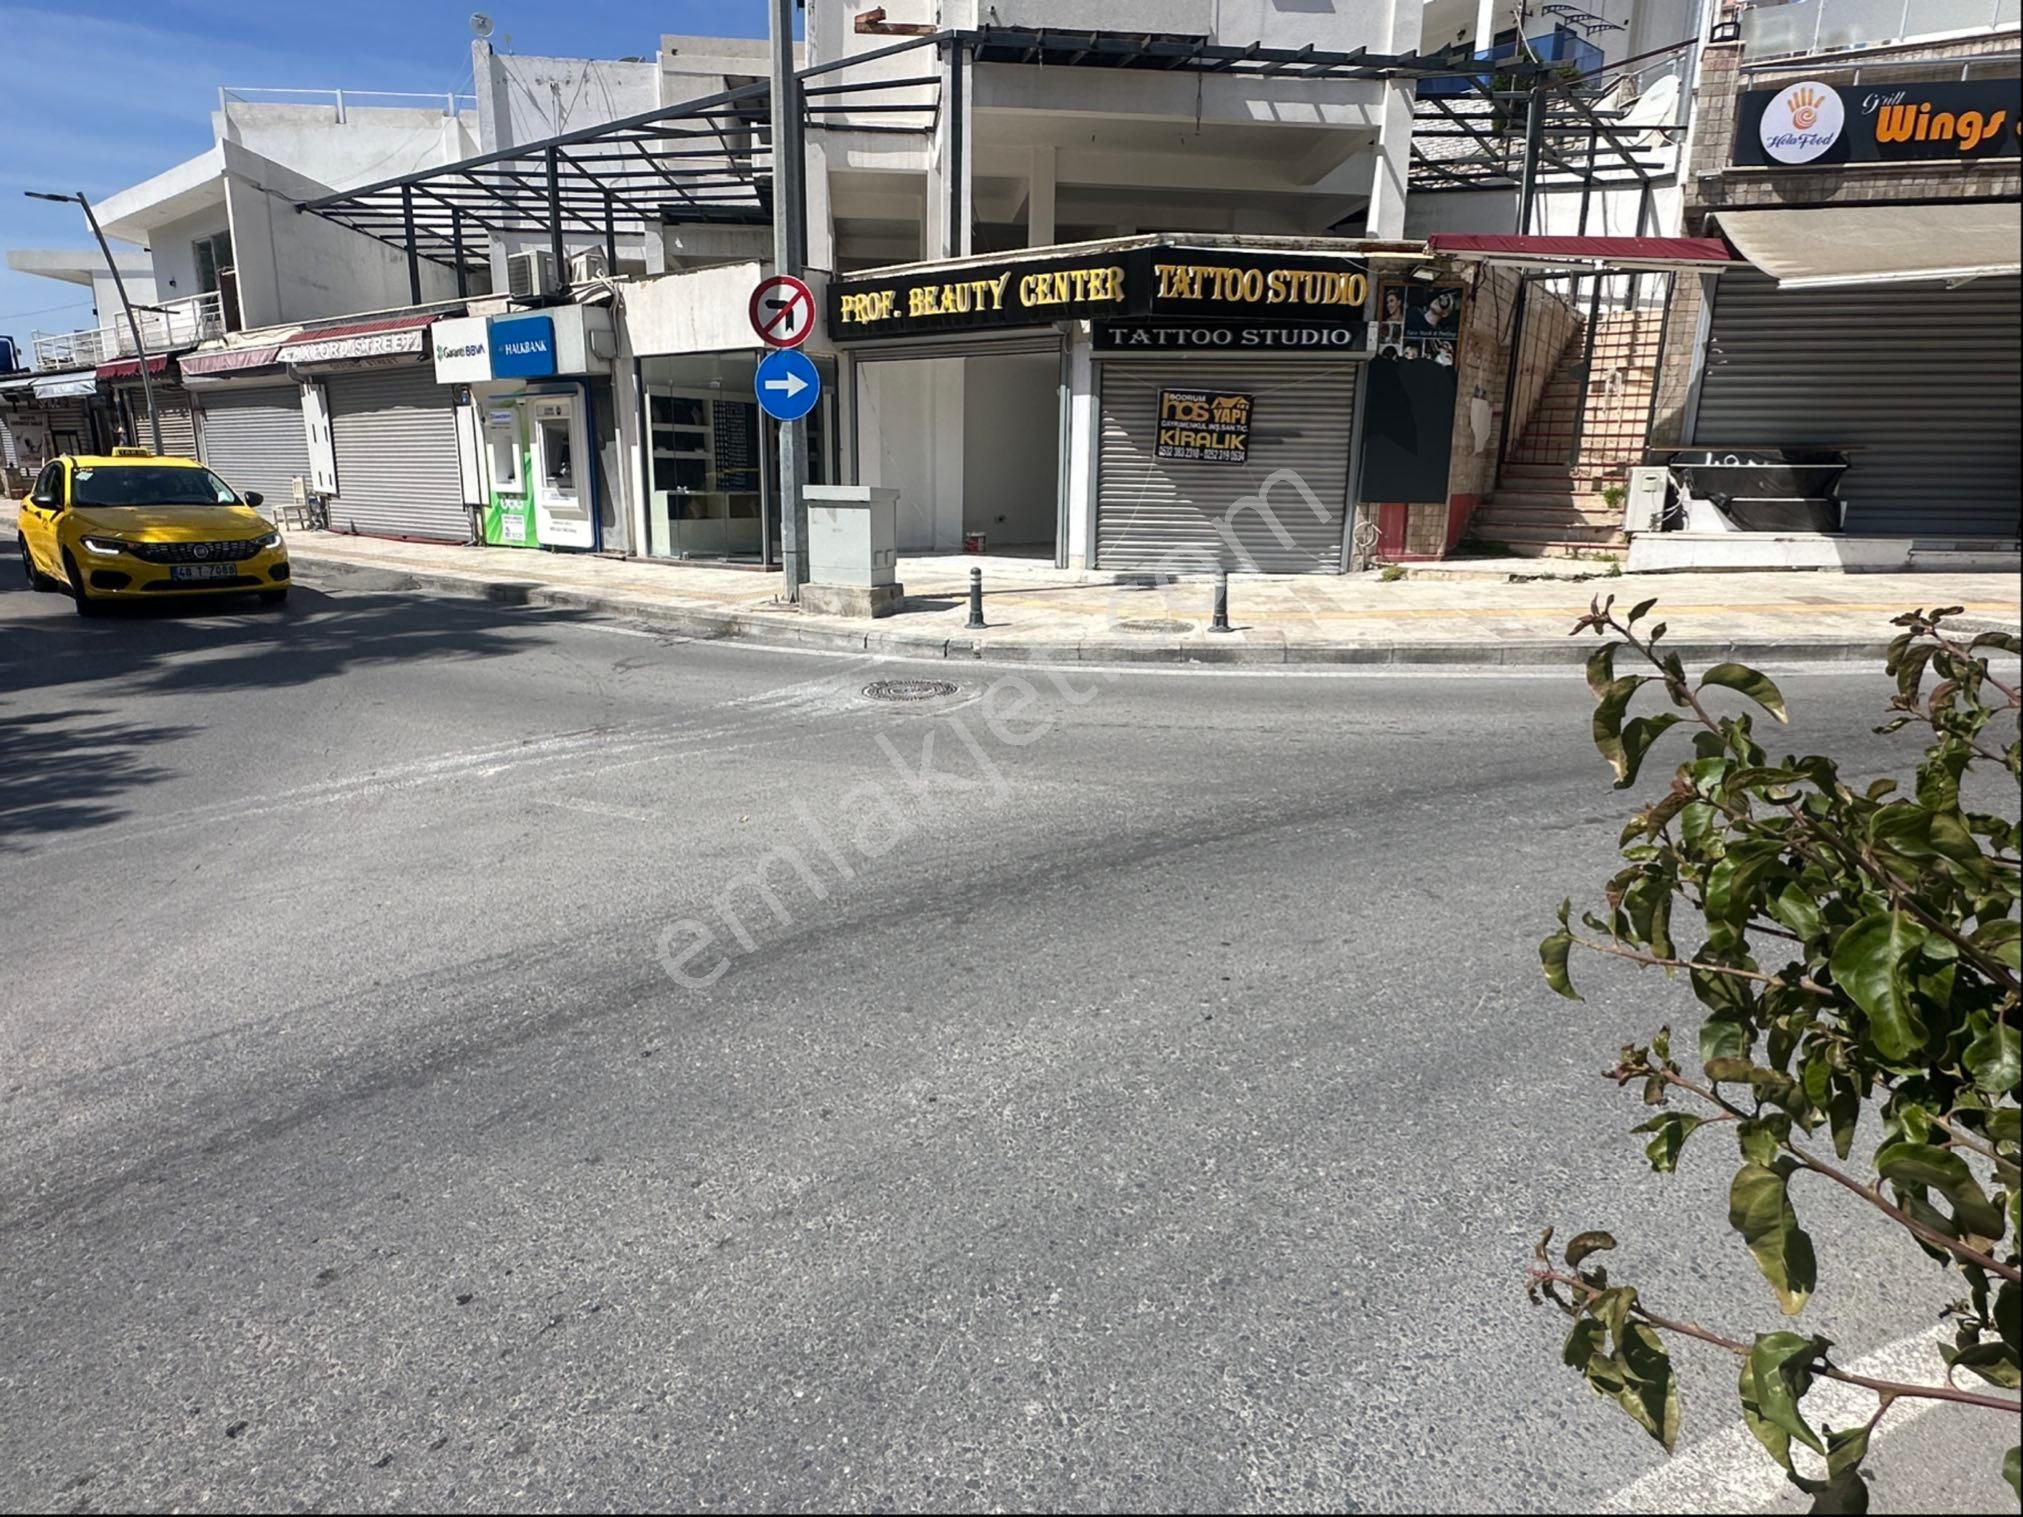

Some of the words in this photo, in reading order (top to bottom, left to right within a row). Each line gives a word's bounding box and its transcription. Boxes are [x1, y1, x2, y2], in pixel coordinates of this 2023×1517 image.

[1861, 91, 1906, 115] Grill
[1875, 102, 2007, 151] Wings
[1799, 132, 1835, 149] Food
[840, 290, 902, 324] PROF.
[908, 270, 1012, 317] BEAUTY
[1019, 266, 1126, 307] CENTER
[1154, 264, 1264, 302] TATTOO
[1265, 269, 1368, 307] STUDIO
[1108, 328, 1232, 345] TATTOO
[1240, 328, 1351, 345] STUDIO
[465, 344, 485, 357] BBVA
[1160, 427, 1247, 450] KİRALIK
